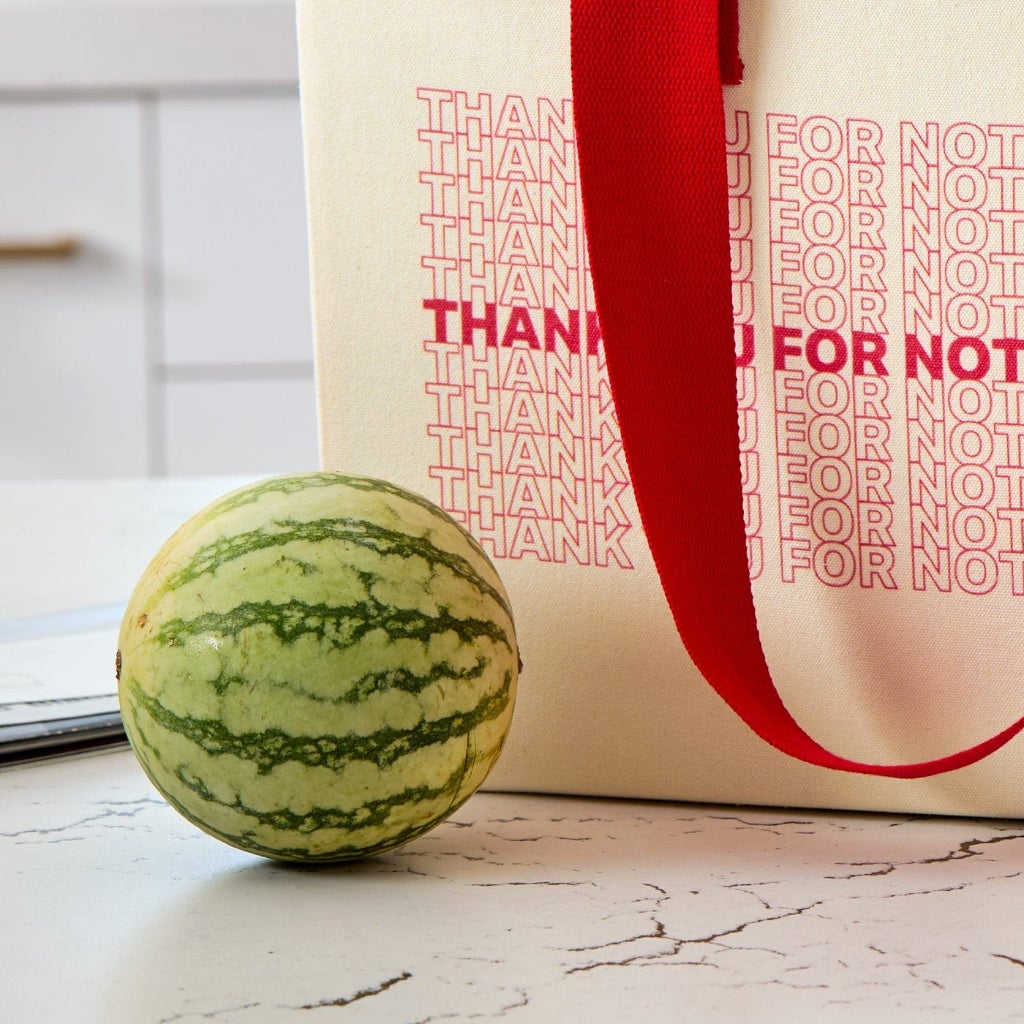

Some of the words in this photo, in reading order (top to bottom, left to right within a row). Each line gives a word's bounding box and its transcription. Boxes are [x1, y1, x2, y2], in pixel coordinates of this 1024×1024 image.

[417, 88, 574, 142] THAN
[766, 113, 884, 165] FOR
[418, 130, 576, 185] THAN
[767, 156, 885, 207] FOR
[420, 172, 583, 227] THAN
[768, 199, 886, 250] FOR
[421, 214, 588, 270] THAN
[769, 241, 887, 292] FOR
[421, 257, 593, 311] THAN
[771, 283, 888, 334] FOR
[772, 325, 889, 376] FOR
[774, 369, 891, 419] FOR
[427, 425, 628, 483] THANK
[777, 454, 894, 505] FOR
[776, 411, 892, 462] FOR
[429, 467, 631, 525] THANK
[779, 495, 896, 546] FOR
[453, 511, 634, 569] HANK
[781, 536, 898, 590] FOR
